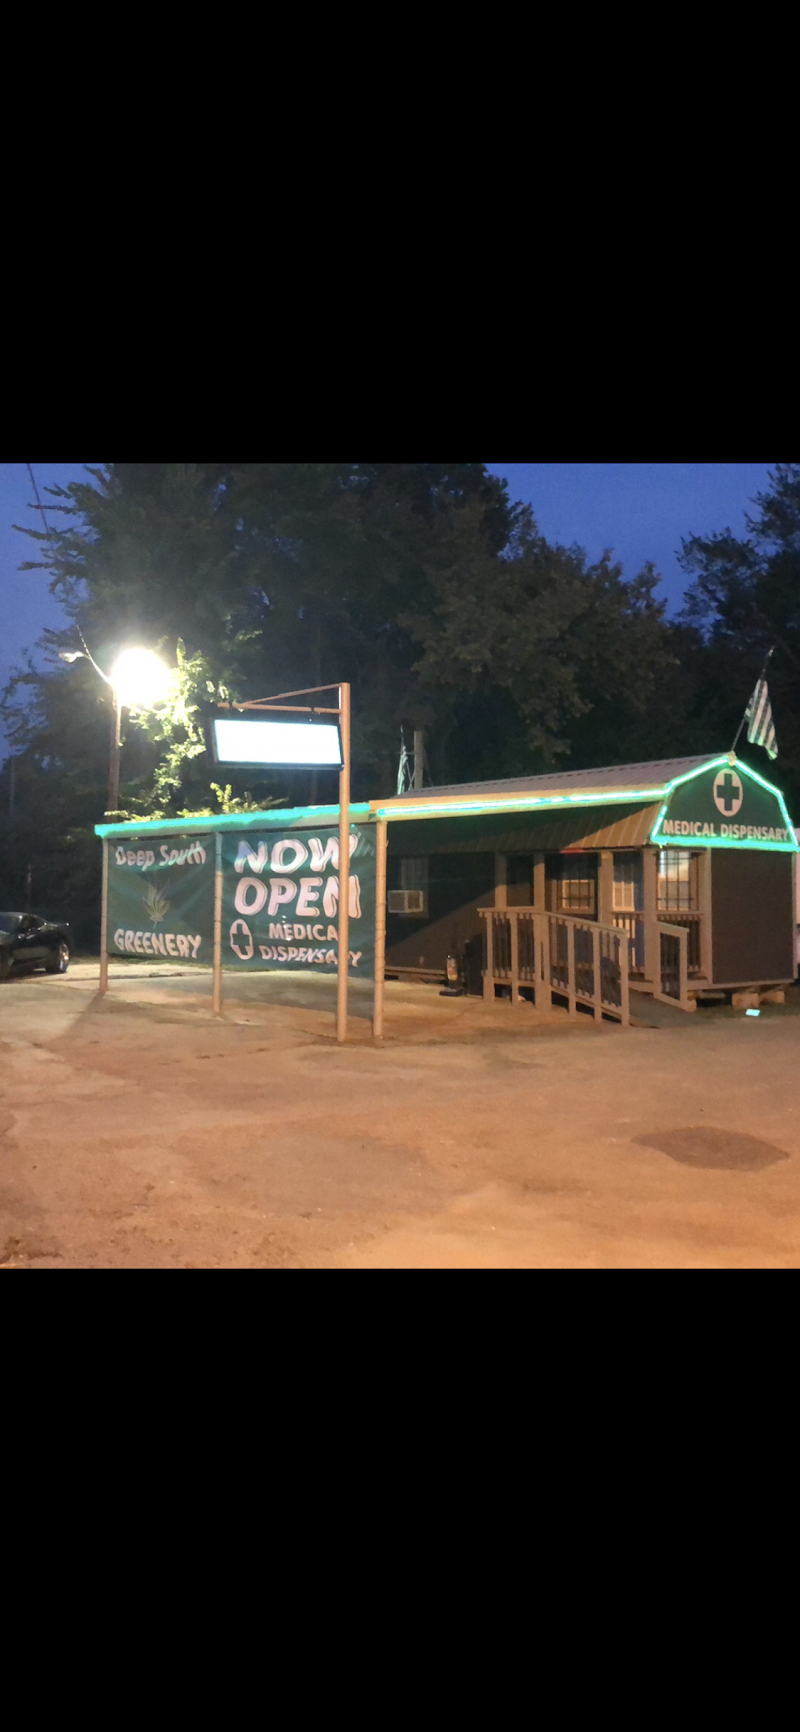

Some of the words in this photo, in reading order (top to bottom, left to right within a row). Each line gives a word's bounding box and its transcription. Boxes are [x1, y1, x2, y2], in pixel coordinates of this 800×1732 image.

[663, 819, 716, 836] MEDICAL
[720, 823, 788, 841] DISPENSARY
[115, 846, 155, 871] Deep
[159, 841, 206, 866] South
[234, 834, 359, 874] NOW
[234, 875, 362, 919] OPEN
[114, 928, 202, 959] GREENERY
[269, 923, 339, 942] MEDICA
[260, 946, 362, 967] DISPENSAY
